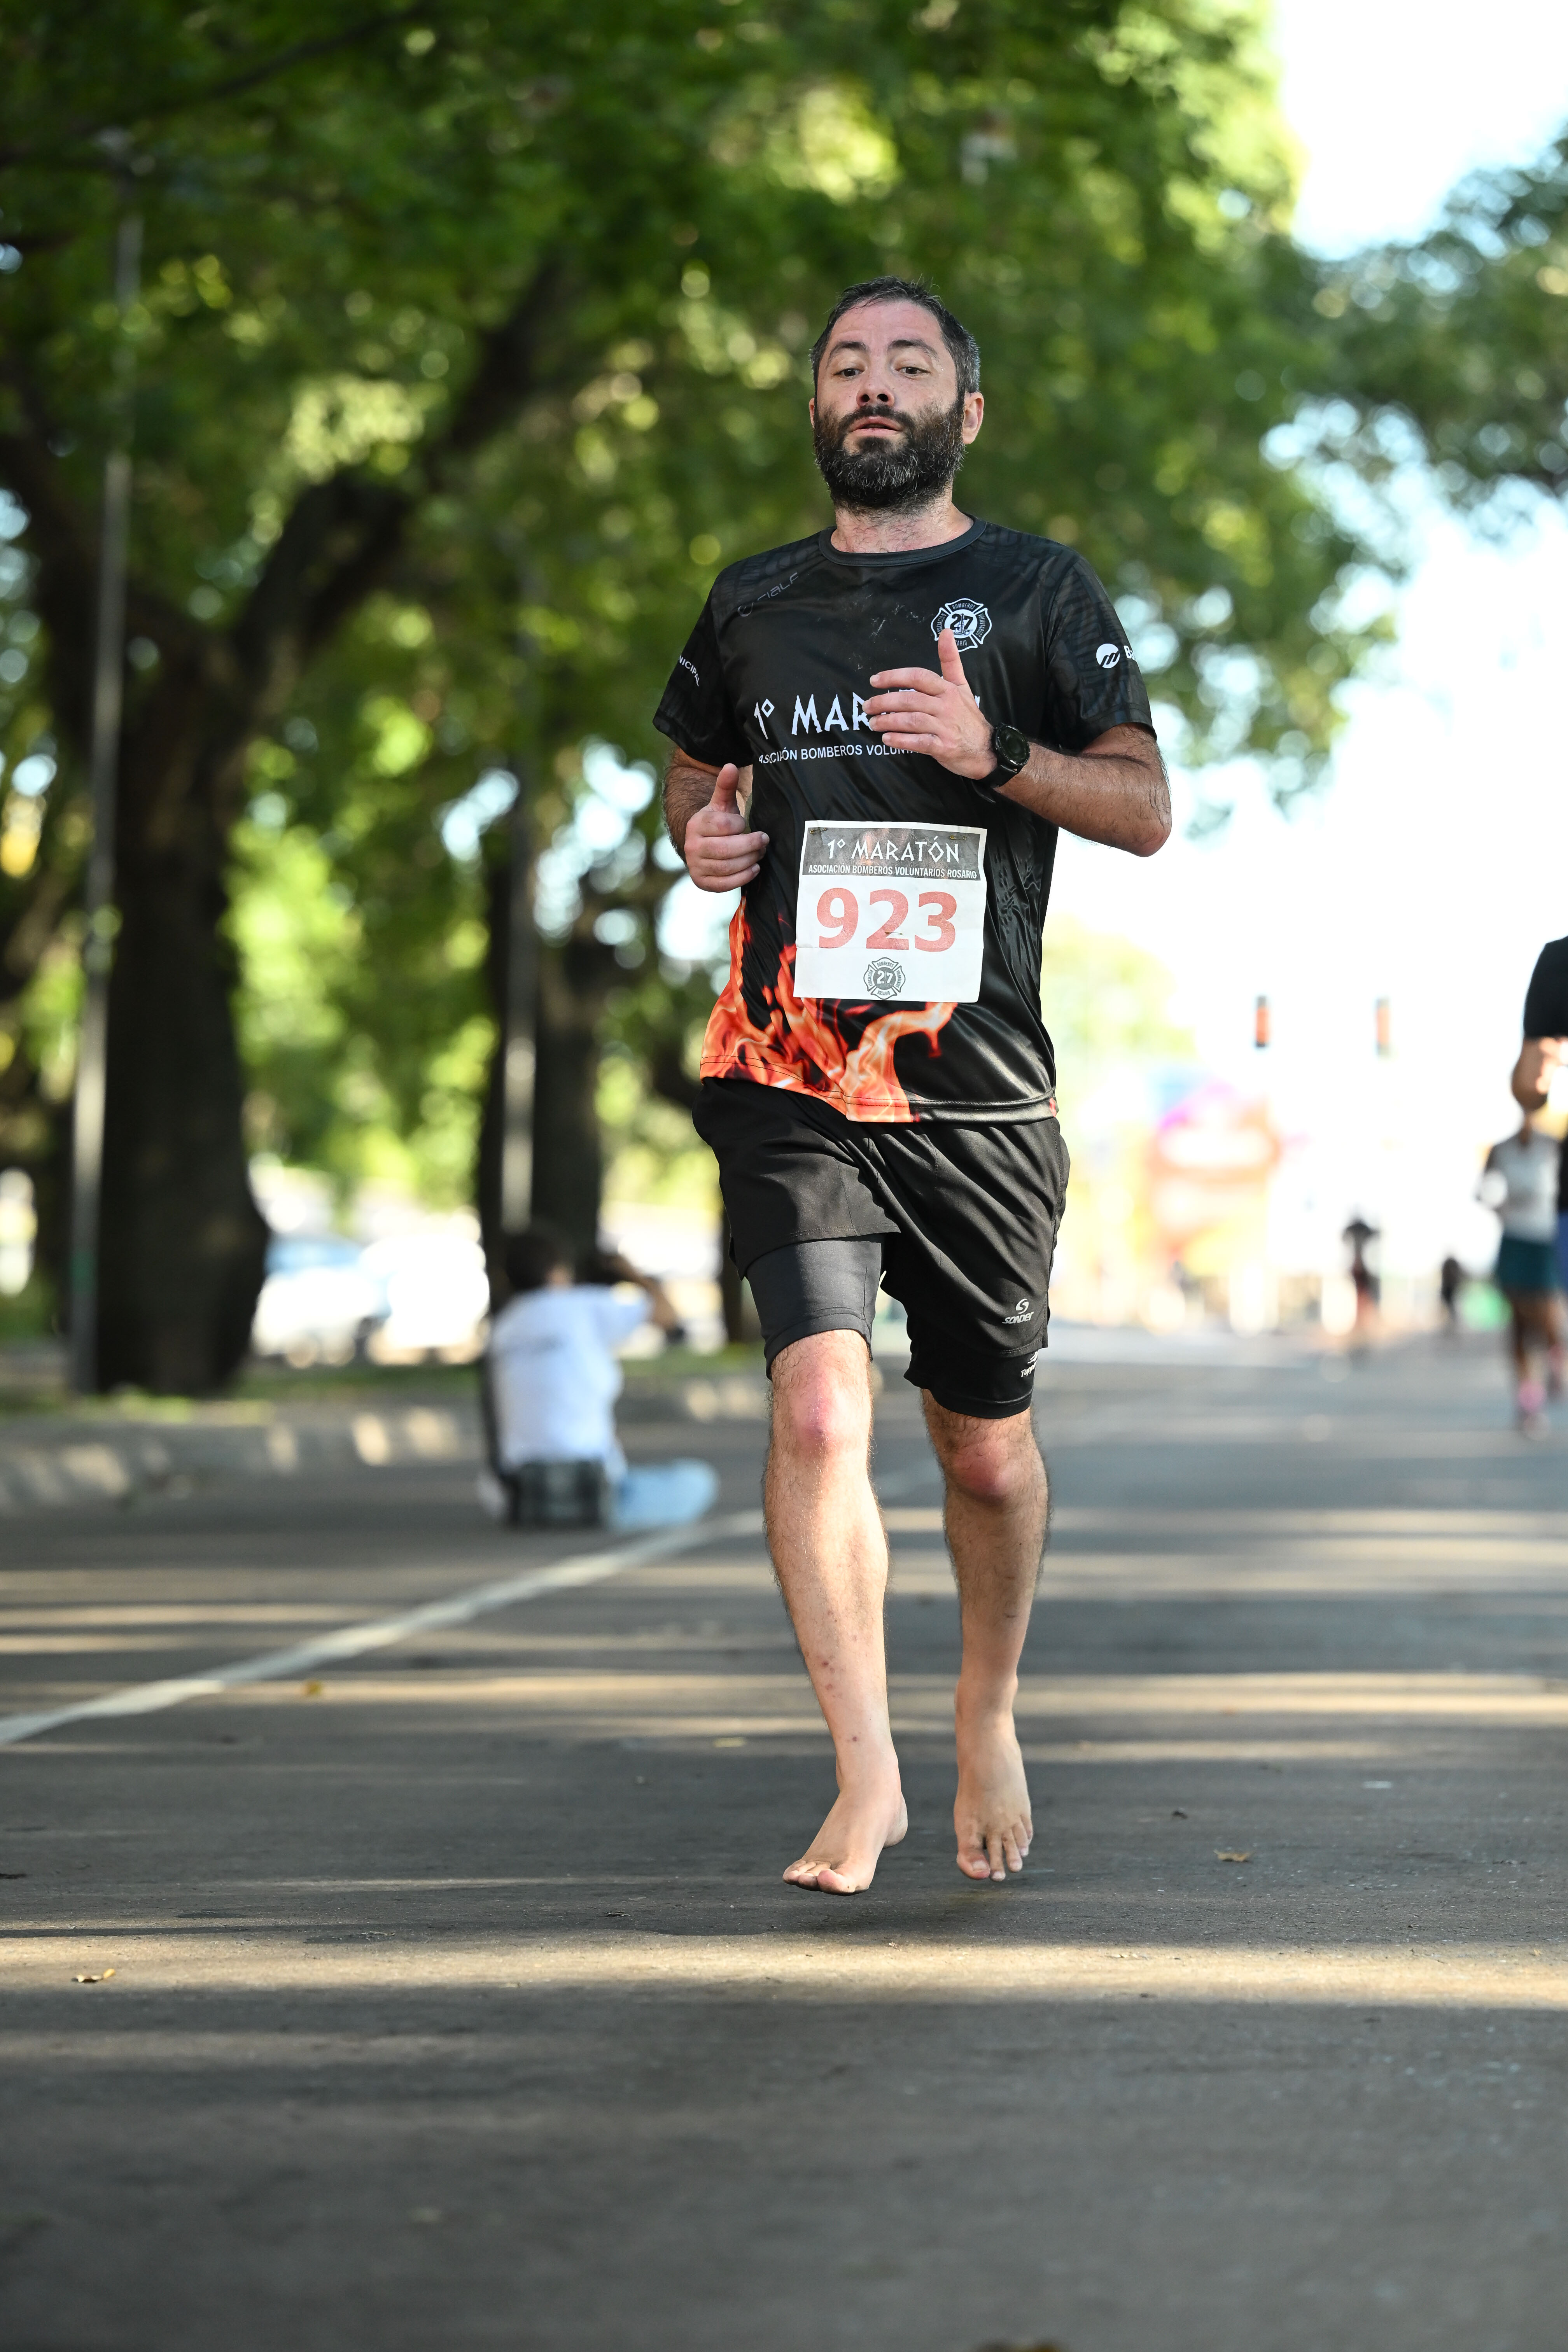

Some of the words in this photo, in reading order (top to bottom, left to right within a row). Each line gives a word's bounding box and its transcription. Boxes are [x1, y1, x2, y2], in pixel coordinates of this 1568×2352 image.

[950, 613, 973, 631] 27
[975, 613, 986, 637] VOLUNTARIOS
[1124, 645, 1136, 661] Ba
[801, 744, 863, 760] BOMBEROS
[850, 836, 959, 863] MARATÓN
[808, 863, 850, 874] ASOCIACIÓN
[852, 865, 893, 875] BOMBEROS
[895, 867, 945, 878] VOLUNTARIOS
[947, 869, 978, 879] ROSARIO
[816, 887, 957, 952] 923
[877, 970, 893, 984] 27
